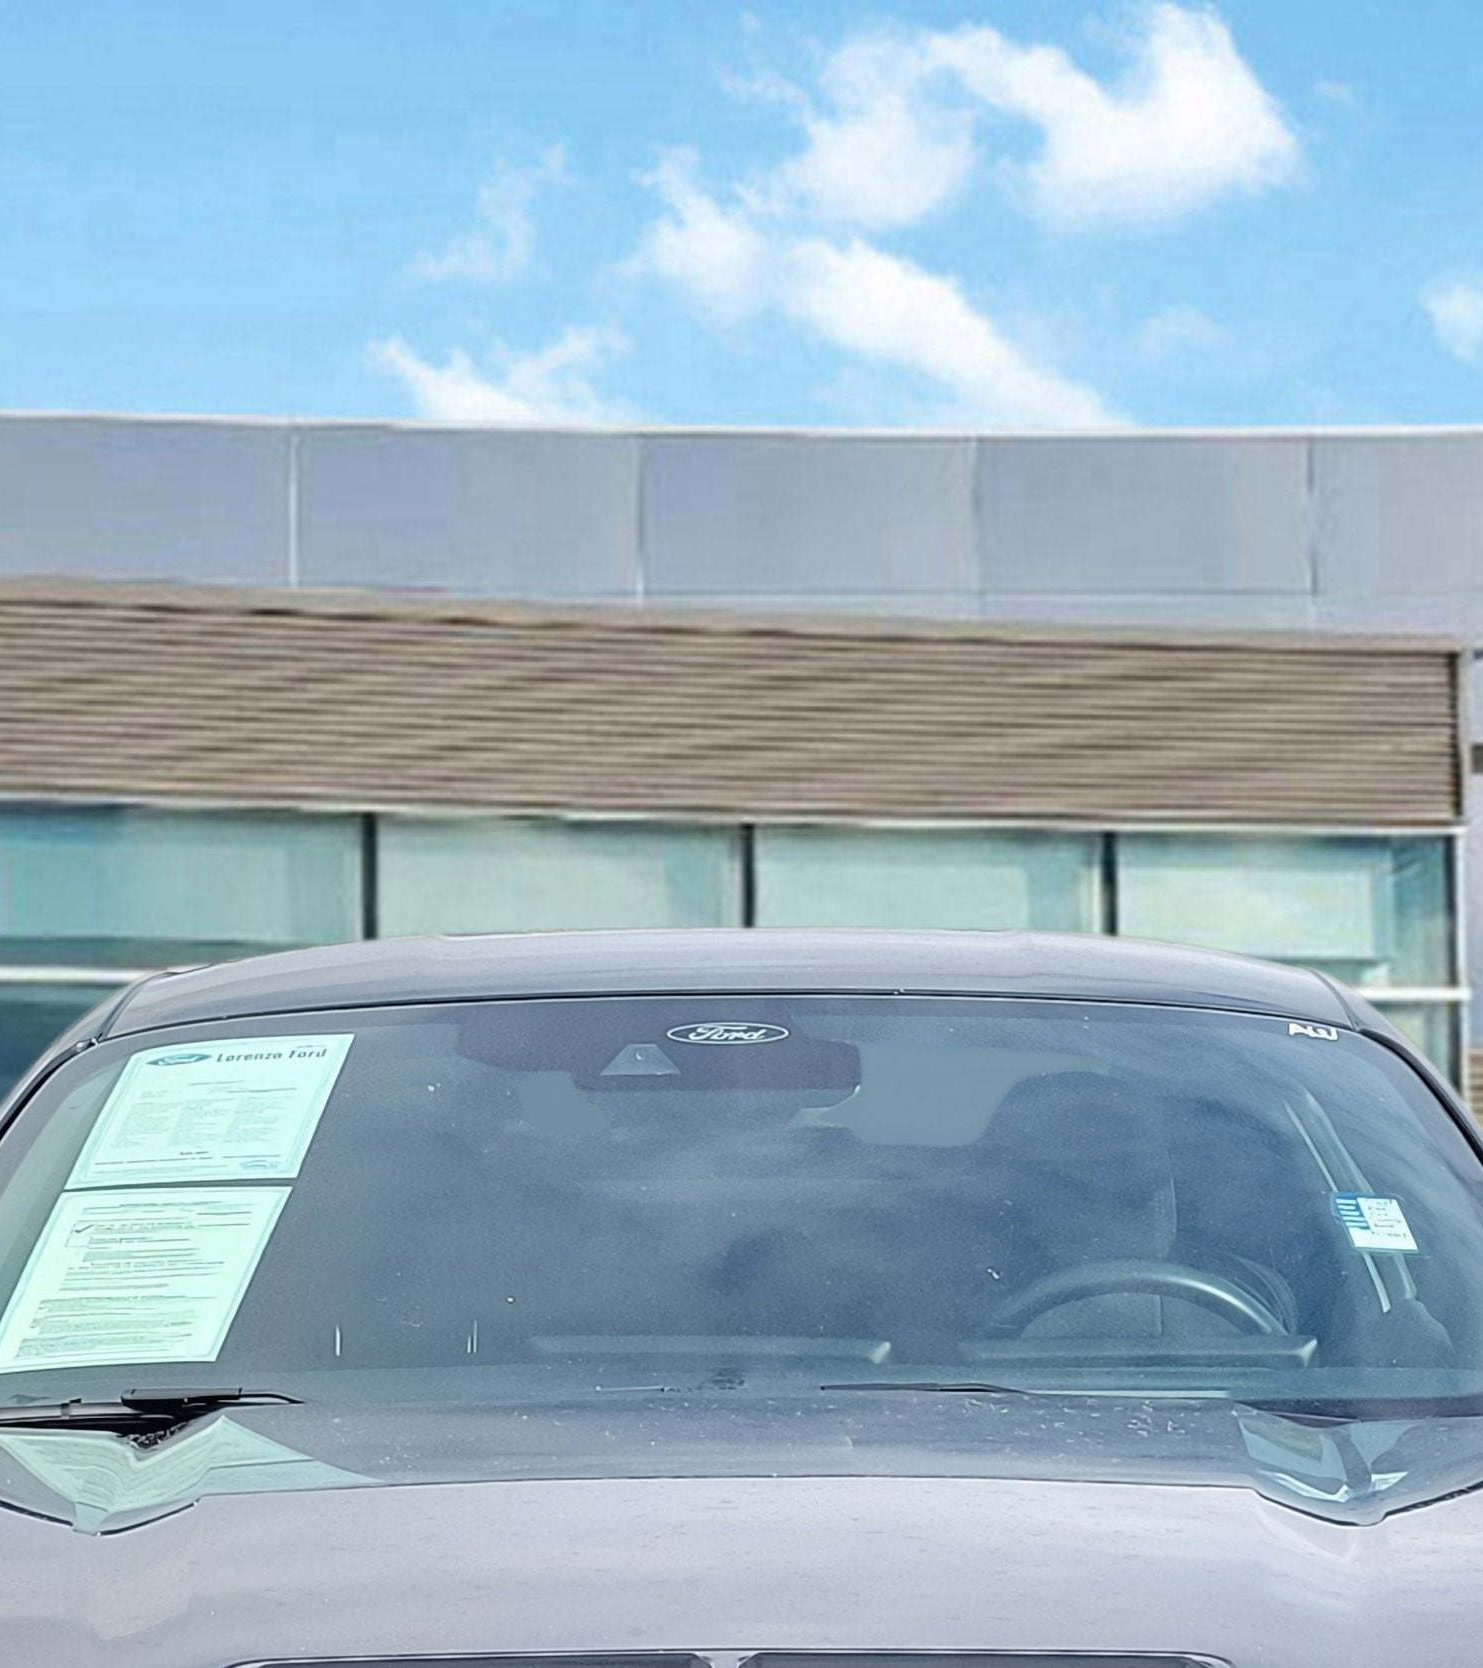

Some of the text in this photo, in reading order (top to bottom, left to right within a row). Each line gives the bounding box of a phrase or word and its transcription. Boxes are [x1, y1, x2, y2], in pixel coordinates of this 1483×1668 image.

[688, 1025, 767, 1040] Ford
[216, 1052, 283, 1063] Lorenzo
[288, 1047, 327, 1059] Ford
